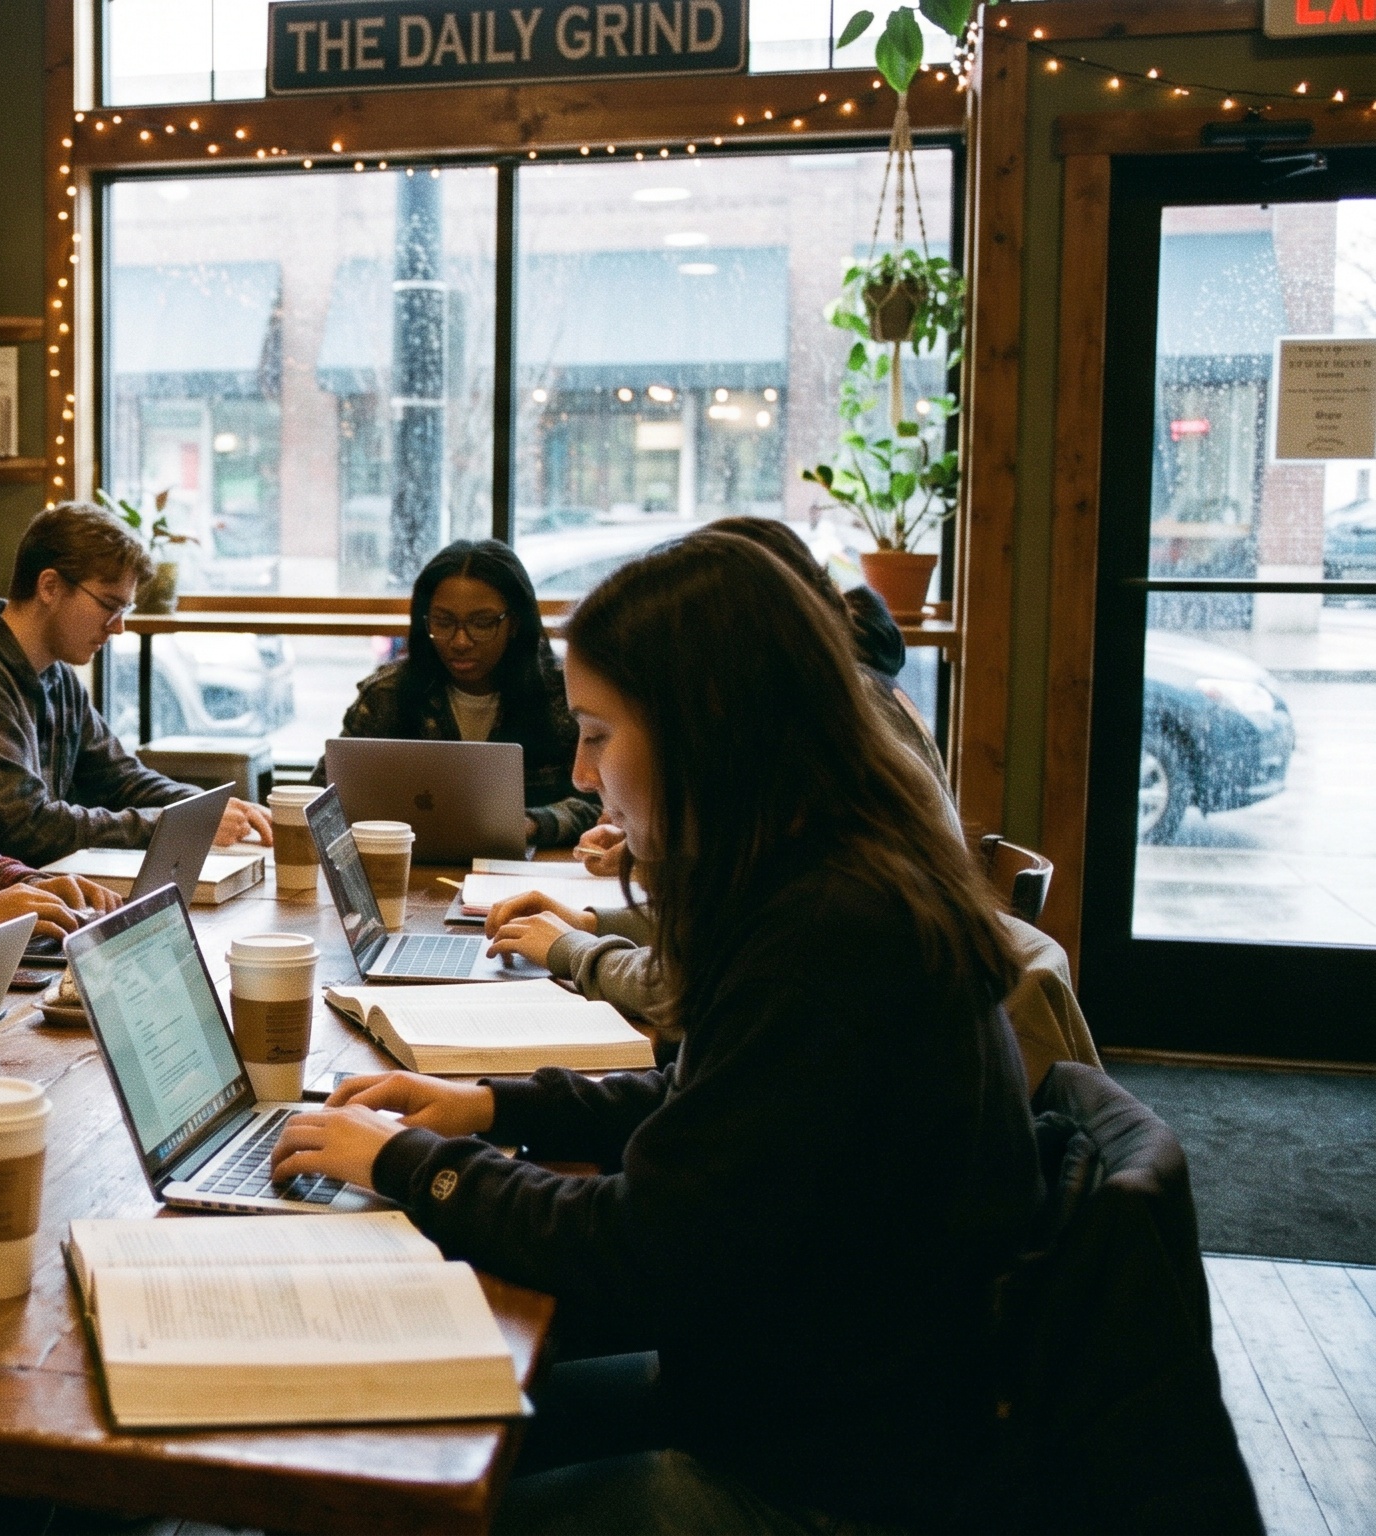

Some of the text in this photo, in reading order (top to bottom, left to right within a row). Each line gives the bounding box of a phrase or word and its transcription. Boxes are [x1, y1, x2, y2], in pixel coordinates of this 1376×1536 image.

[286, 0, 724, 73] THE DAILY GRIND
